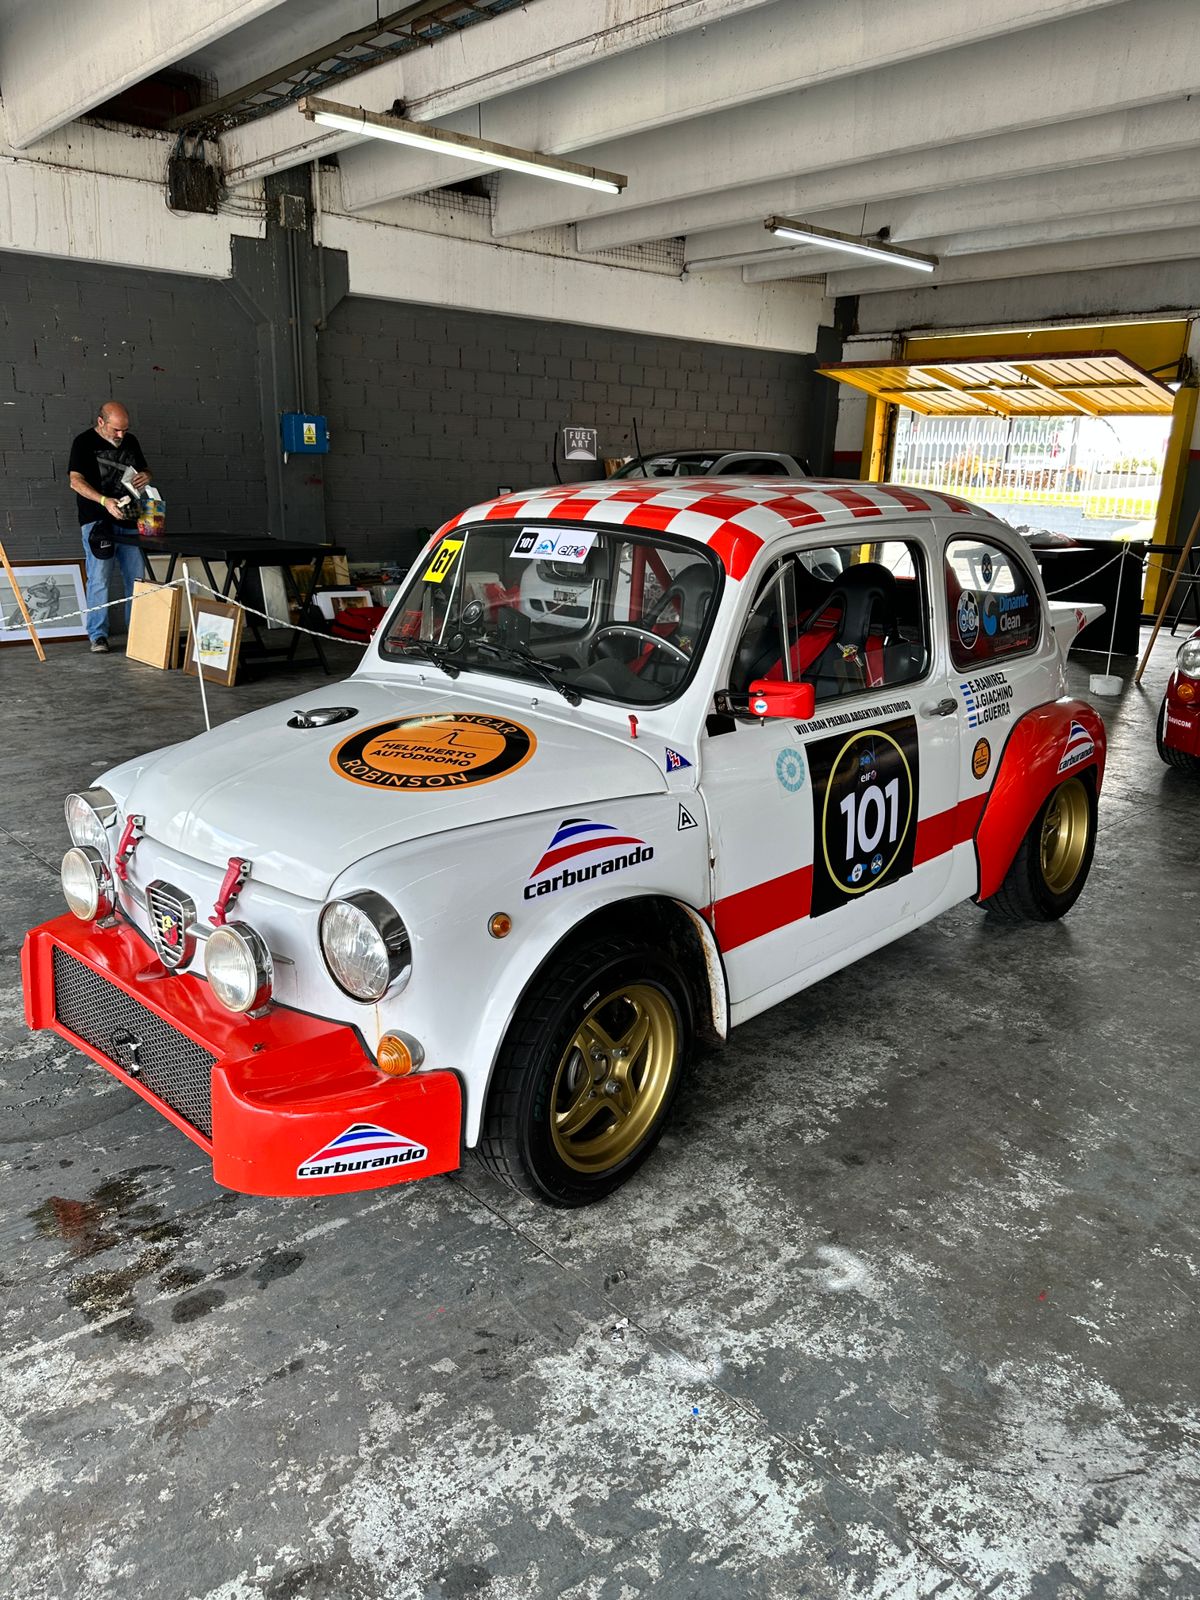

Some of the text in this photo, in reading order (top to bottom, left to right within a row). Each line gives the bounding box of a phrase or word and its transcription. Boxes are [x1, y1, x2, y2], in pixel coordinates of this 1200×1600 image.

[569, 431, 592, 440] FUEL
[571, 439, 590, 448] ART
[519, 537, 536, 549] 101
[557, 545, 577, 556] elf
[431, 548, 457, 574] G1
[998, 590, 1029, 613] Dinamic
[1000, 613, 1021, 632] Clean
[967, 672, 1008, 693] E.RAMIREZ
[975, 685, 1013, 709] J.GIACHINO
[794, 700, 912, 735] VIII GRAN PREMIO ARGENTINO HISTORICO
[977, 702, 1011, 725] L.GUERRA
[382, 742, 477, 759] HELIPUERTO
[1058, 744, 1095, 771] carburando
[342, 759, 468, 787] ROBINSON
[860, 772, 872, 783] elf
[681, 812, 692, 827] A
[839, 777, 899, 861] 101
[523, 846, 654, 900] carburando
[298, 1148, 425, 1176] carburando
